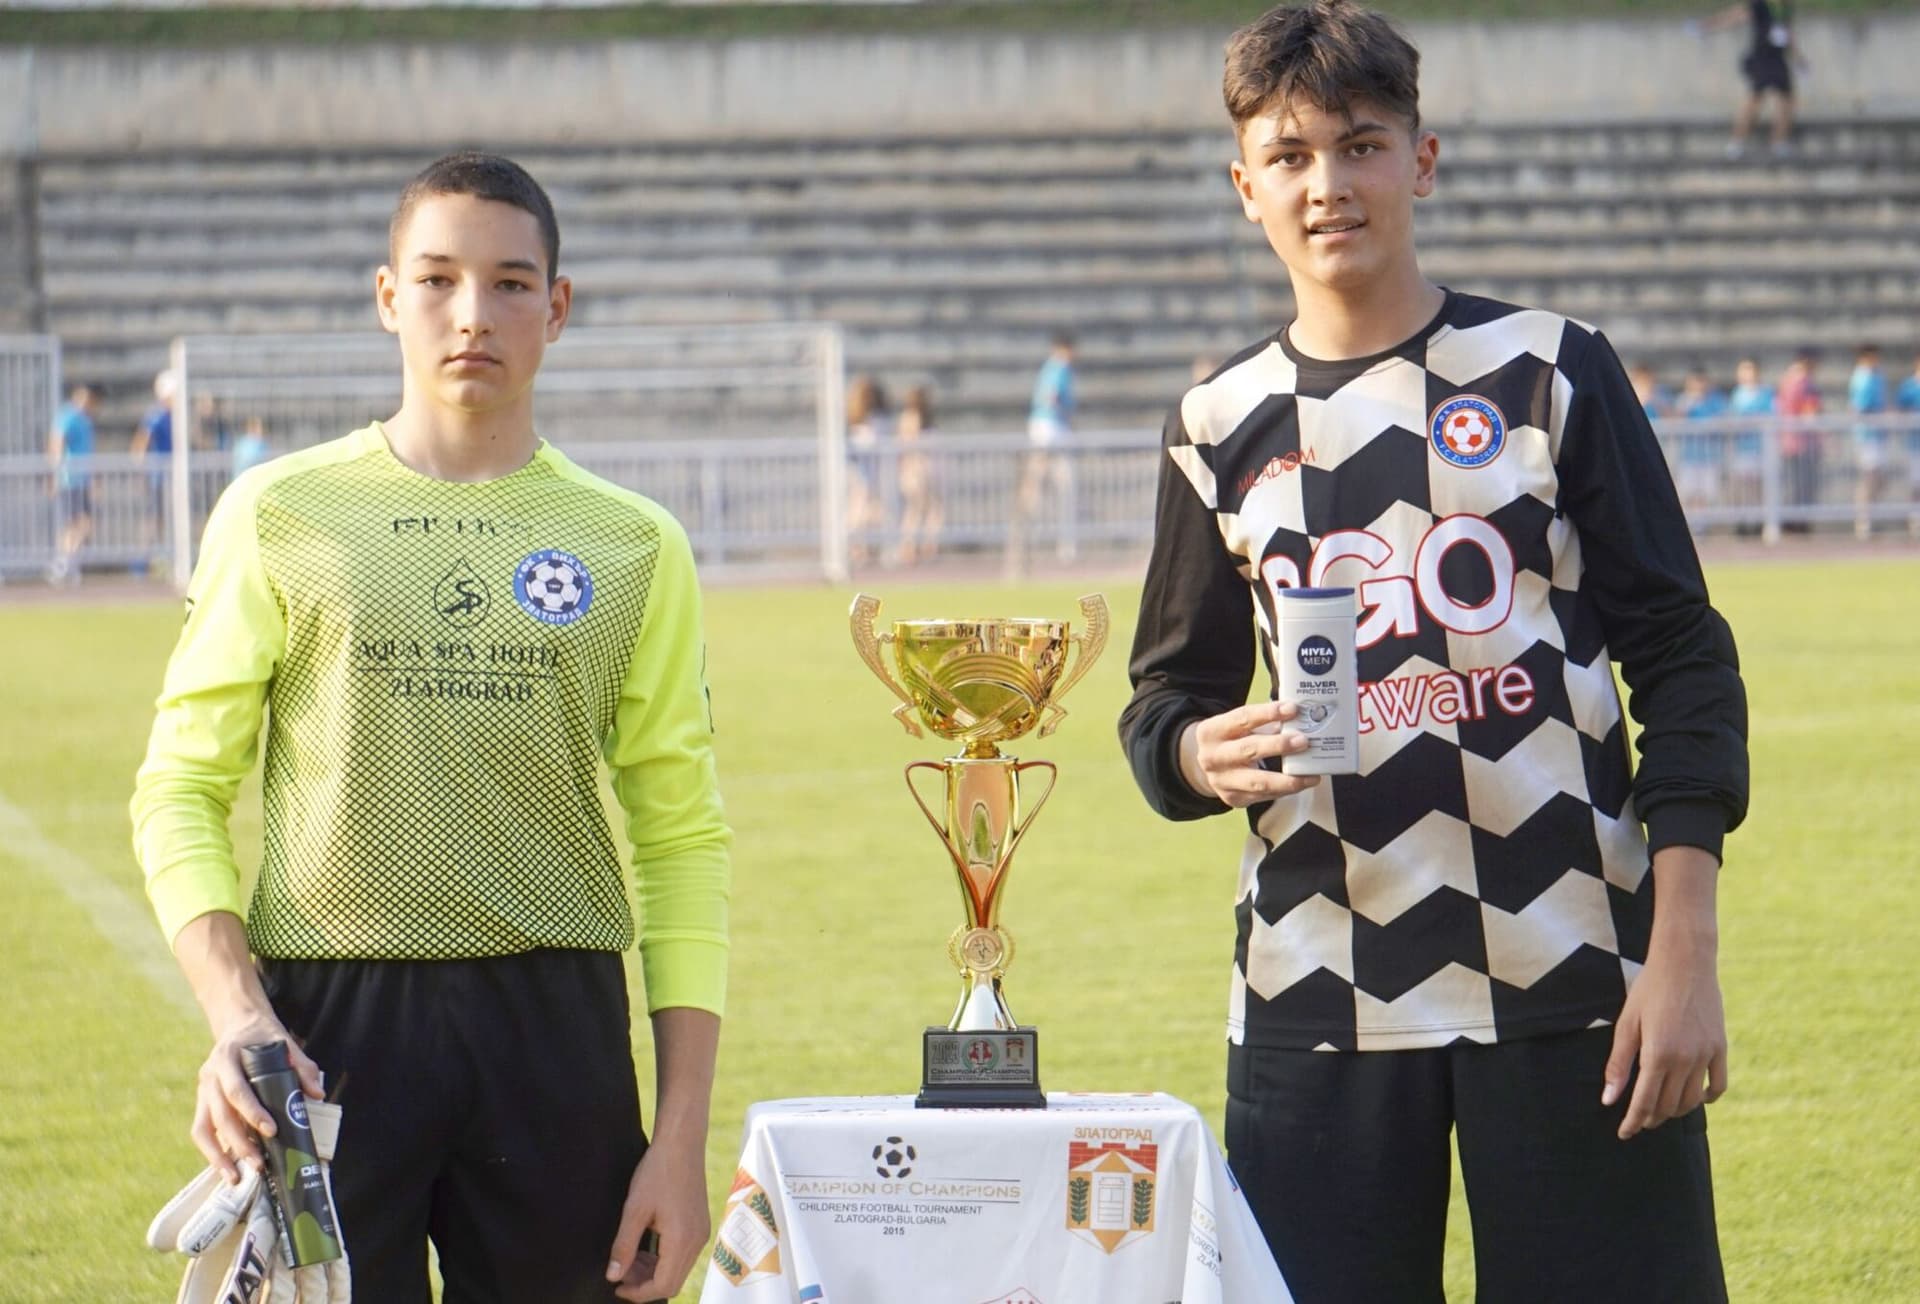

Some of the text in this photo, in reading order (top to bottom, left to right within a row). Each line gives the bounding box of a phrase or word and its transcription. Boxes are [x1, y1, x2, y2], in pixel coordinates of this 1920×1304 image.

[1236, 445, 1316, 496] MILADOM
[1259, 513, 1517, 650] GO
[1301, 647, 1334, 657] NIVEA
[1304, 657, 1331, 666] MEN
[1074, 1127, 1153, 1141] ЗЛАТОГРАД
[785, 1181, 876, 1195] HAMPION
[799, 1202, 983, 1215] CHILDREN'S FOOTBALL TOURNAMENT
[834, 1214, 947, 1225] ZLATOGRAD-BULGARIA
[883, 1226, 905, 1235] 2015
